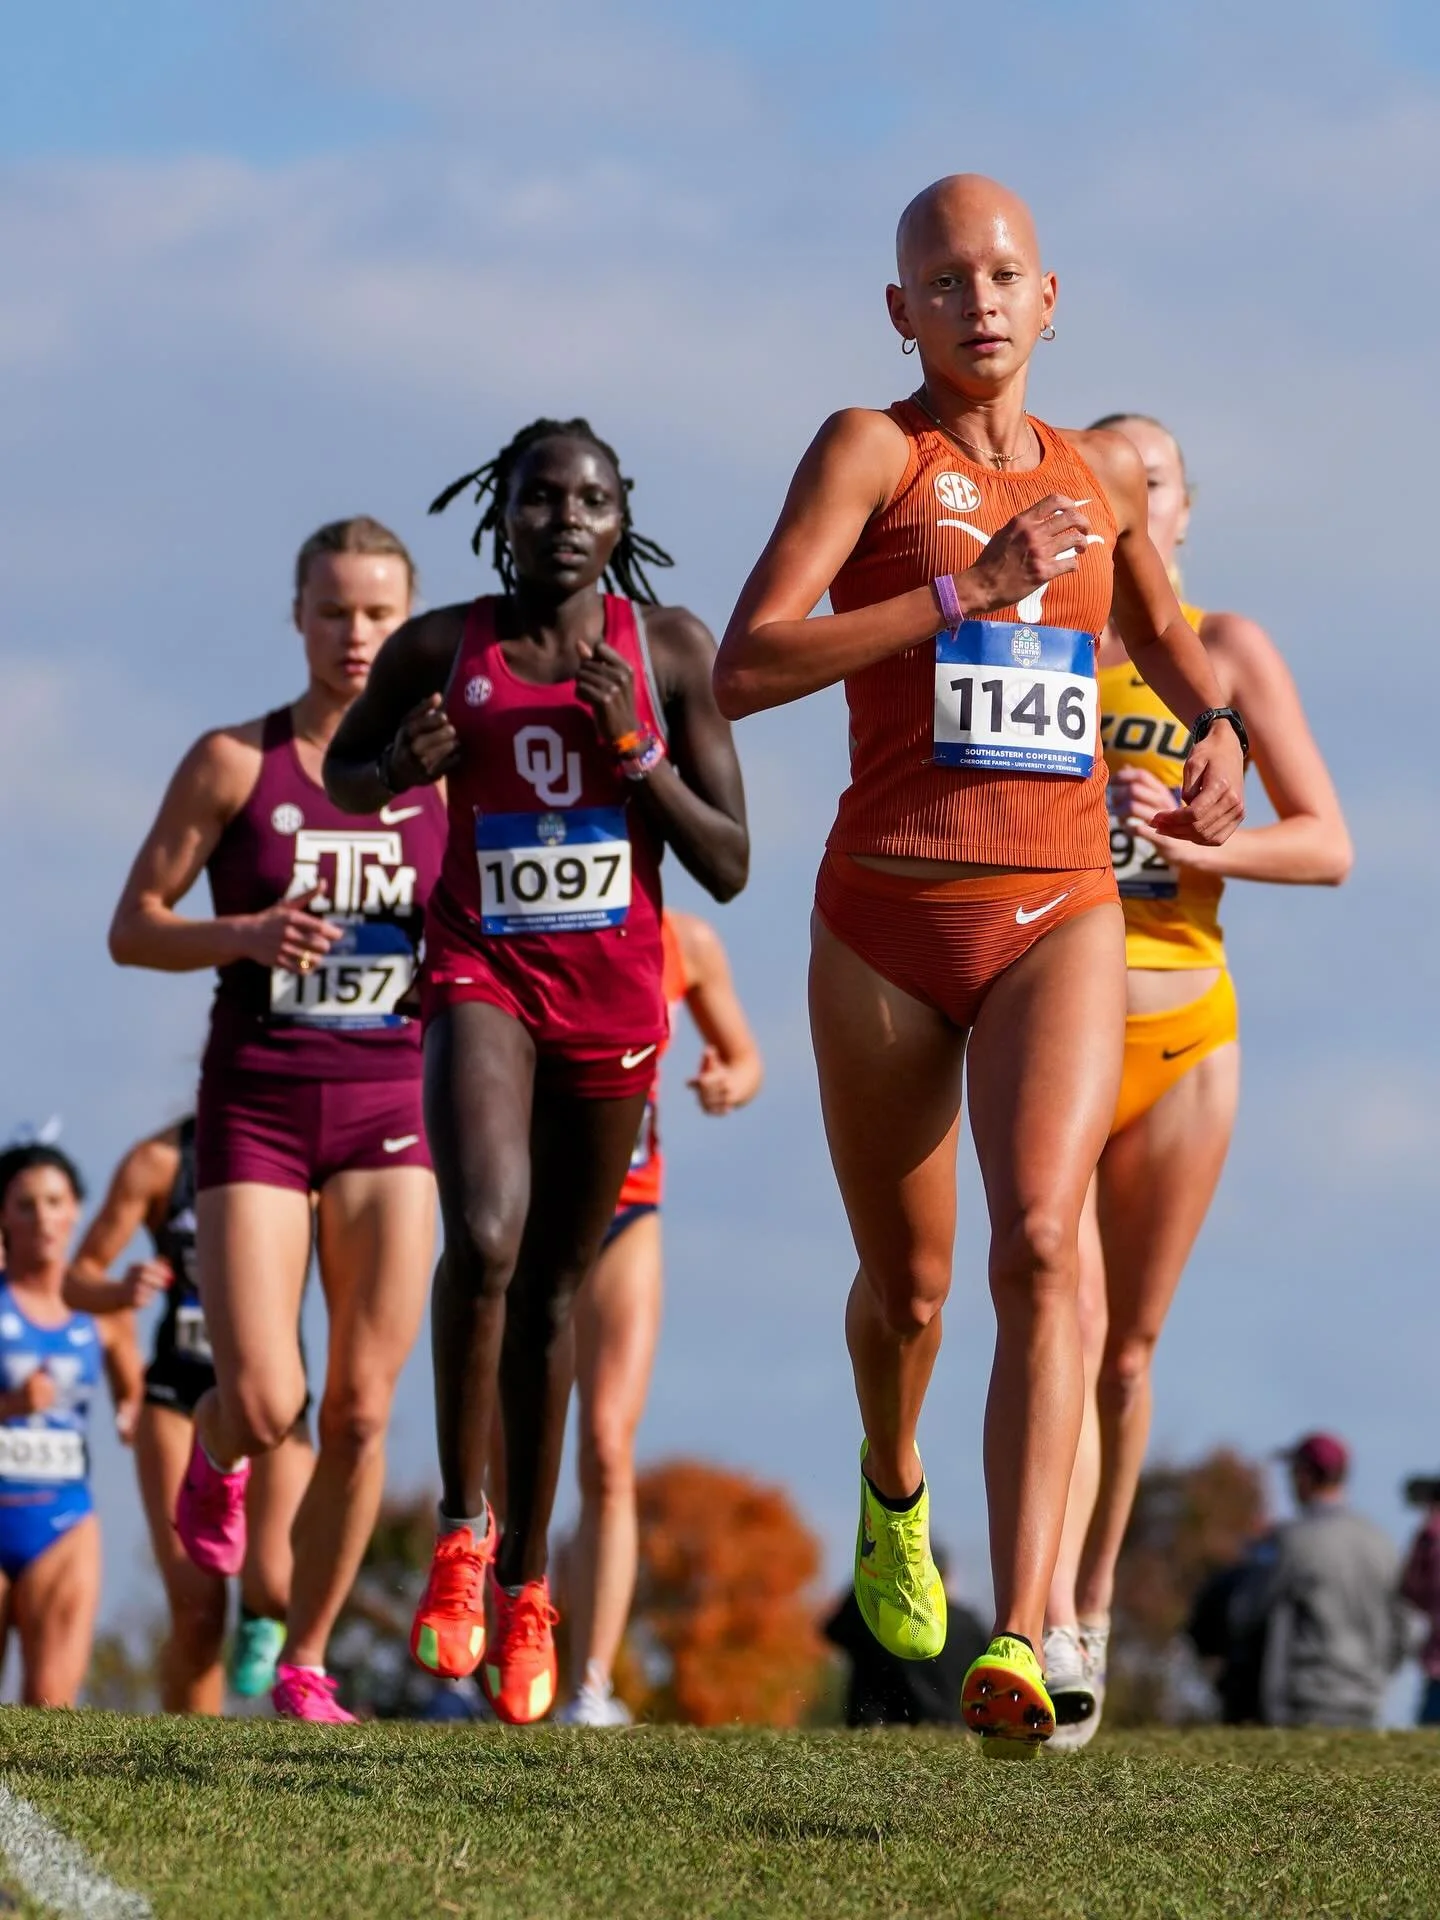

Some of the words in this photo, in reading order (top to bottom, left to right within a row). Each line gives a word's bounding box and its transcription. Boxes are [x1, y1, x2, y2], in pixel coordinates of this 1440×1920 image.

[937, 474, 978, 510] SEC
[1013, 640, 1040, 651] CROSS
[950, 677, 1086, 740] 1146
[513, 725, 582, 807] OU
[960, 758, 991, 766] CHEROKEE
[1015, 762, 1046, 770] UNIVERSITY
[1056, 764, 1082, 773] TENNESSEE
[965, 748, 1023, 758] SOUTHEASTERN
[1026, 752, 1077, 763] CONFERENCE
[486, 854, 621, 904] 1097
[291, 966, 394, 1004] 1157
